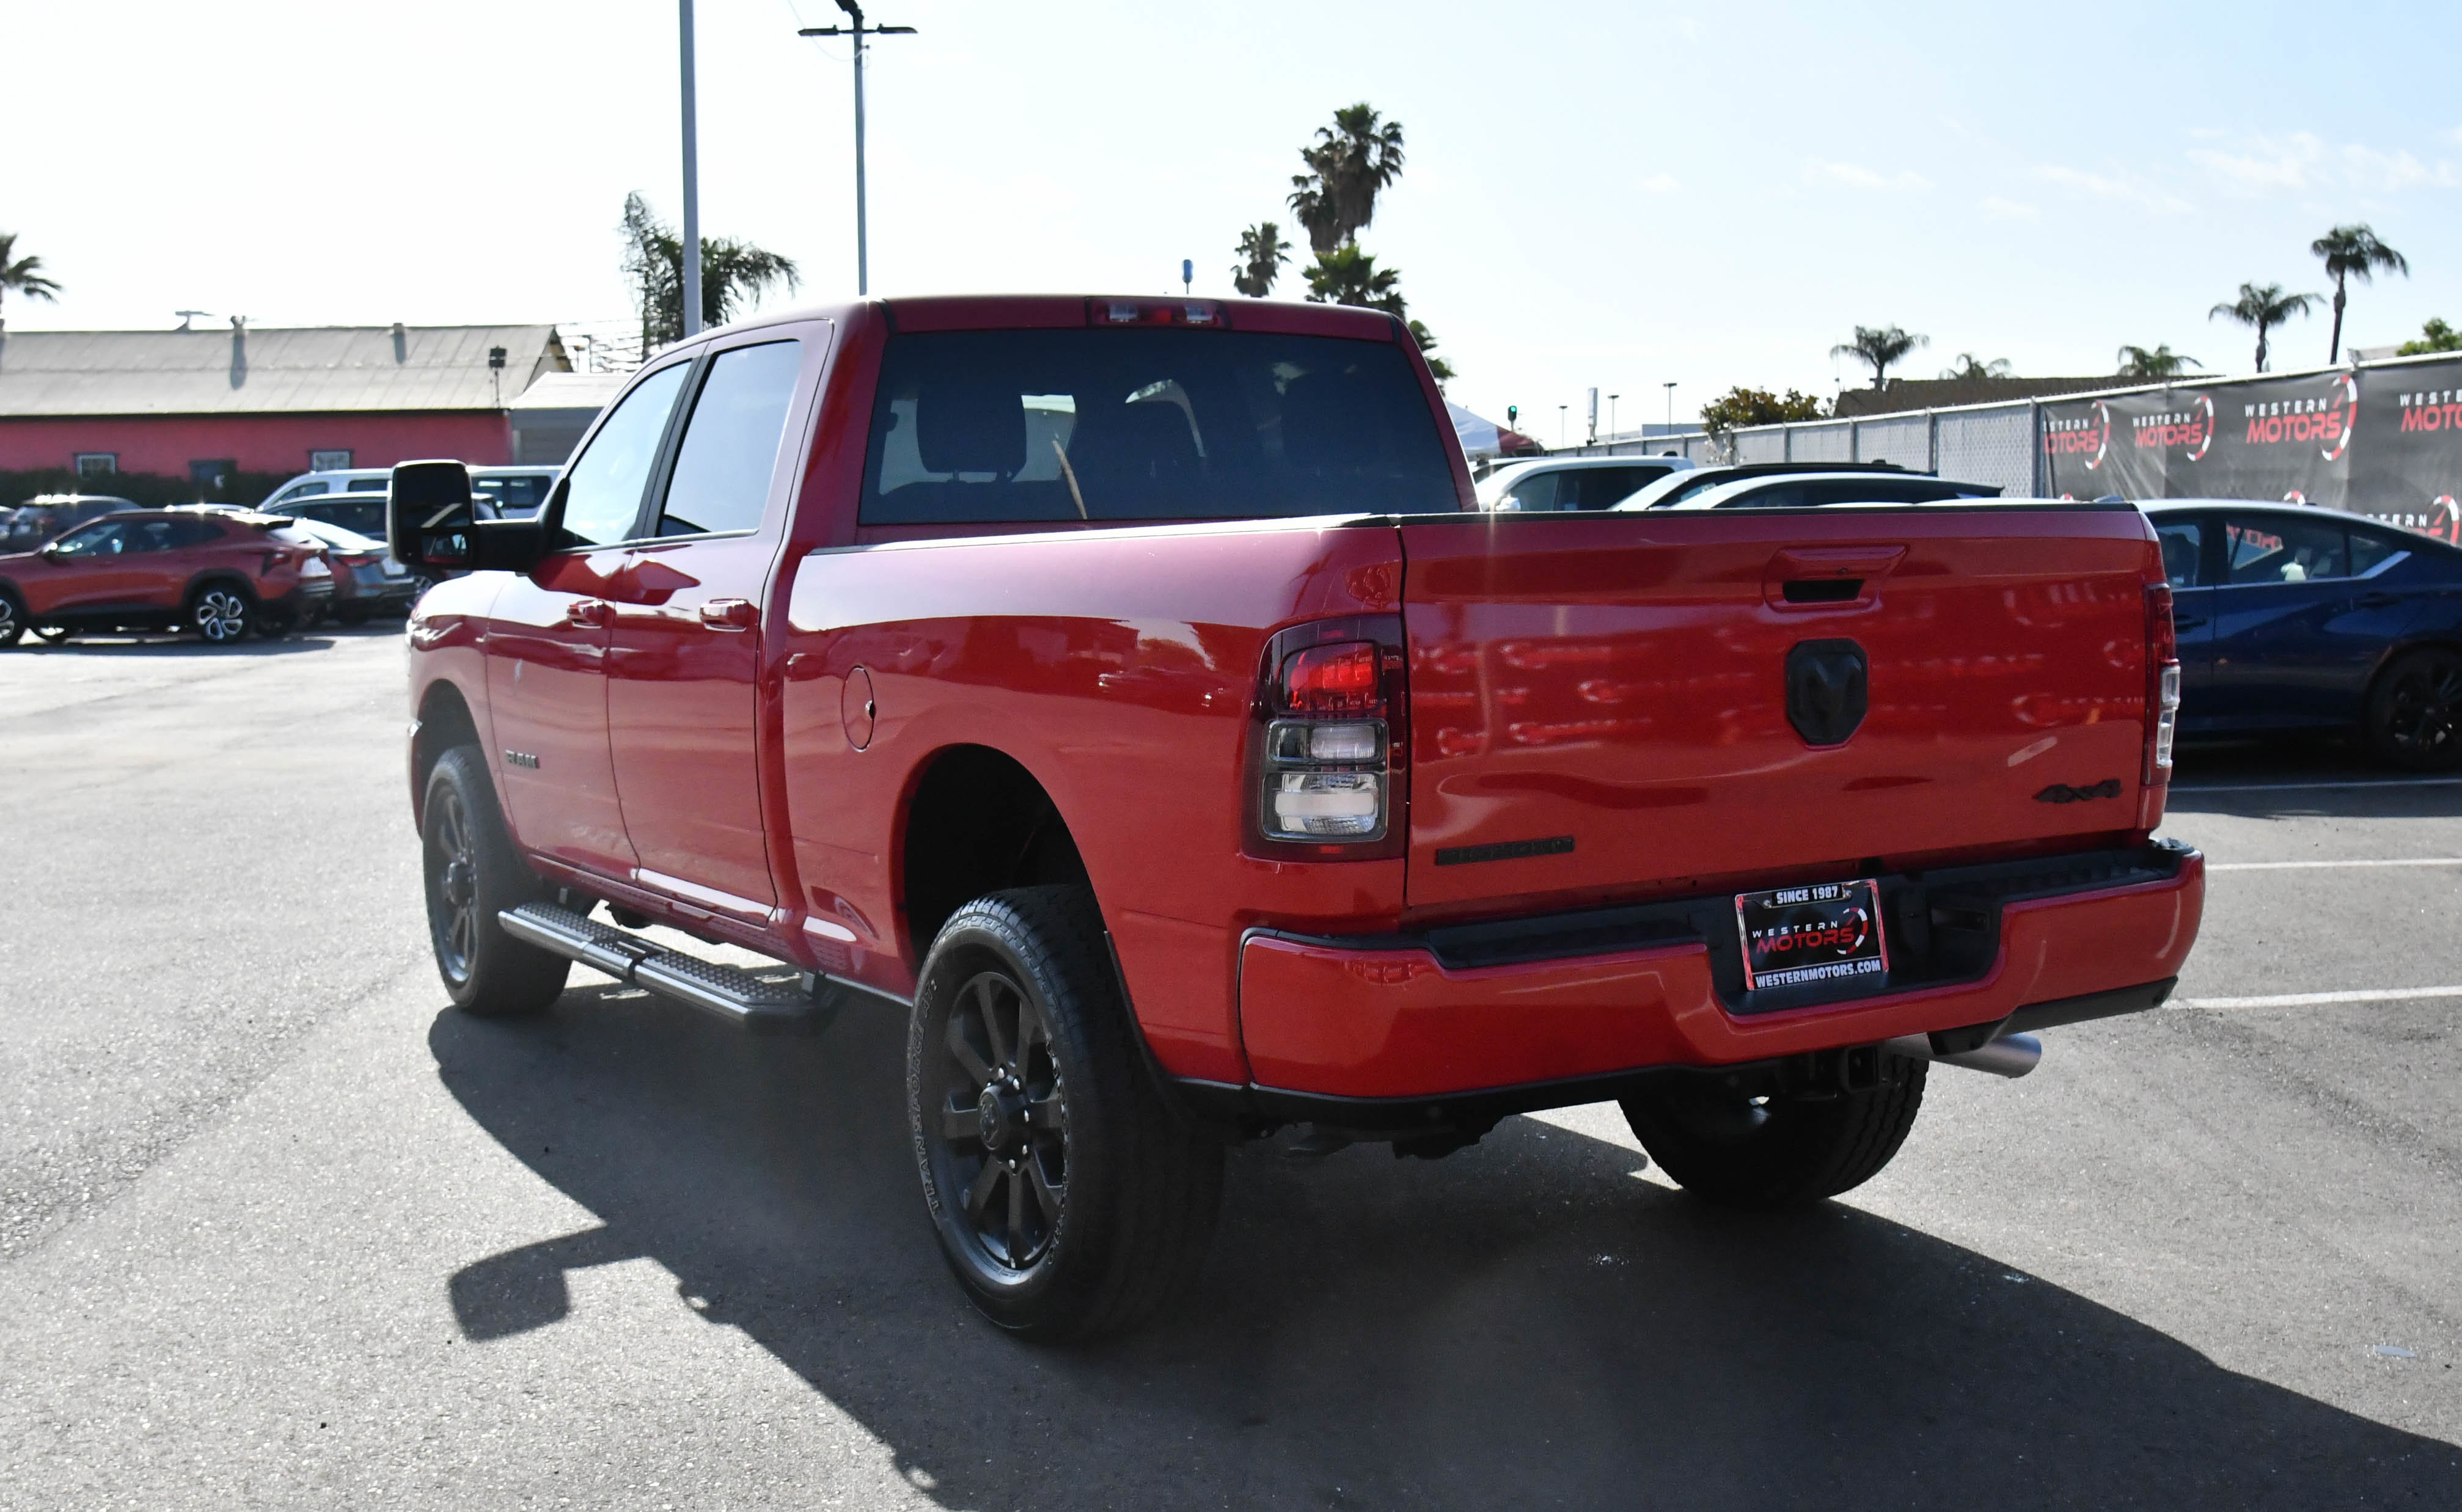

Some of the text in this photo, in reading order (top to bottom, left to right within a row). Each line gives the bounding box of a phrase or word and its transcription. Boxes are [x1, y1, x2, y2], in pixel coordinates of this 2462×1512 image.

[2132, 412, 2191, 427] WESTERN
[2244, 398, 2327, 417] WESTERN
[2134, 423, 2204, 448] MOTORS
[2246, 412, 2342, 444] MOTORS
[1776, 886, 1839, 904] SINCE 1987
[1752, 921, 1837, 938] WESTERN
[1756, 927, 1855, 954] MOTORS
[1755, 960, 1881, 988] WESTERNMOTORS.COM
[909, 1019, 940, 1214] TRANSFORCE
